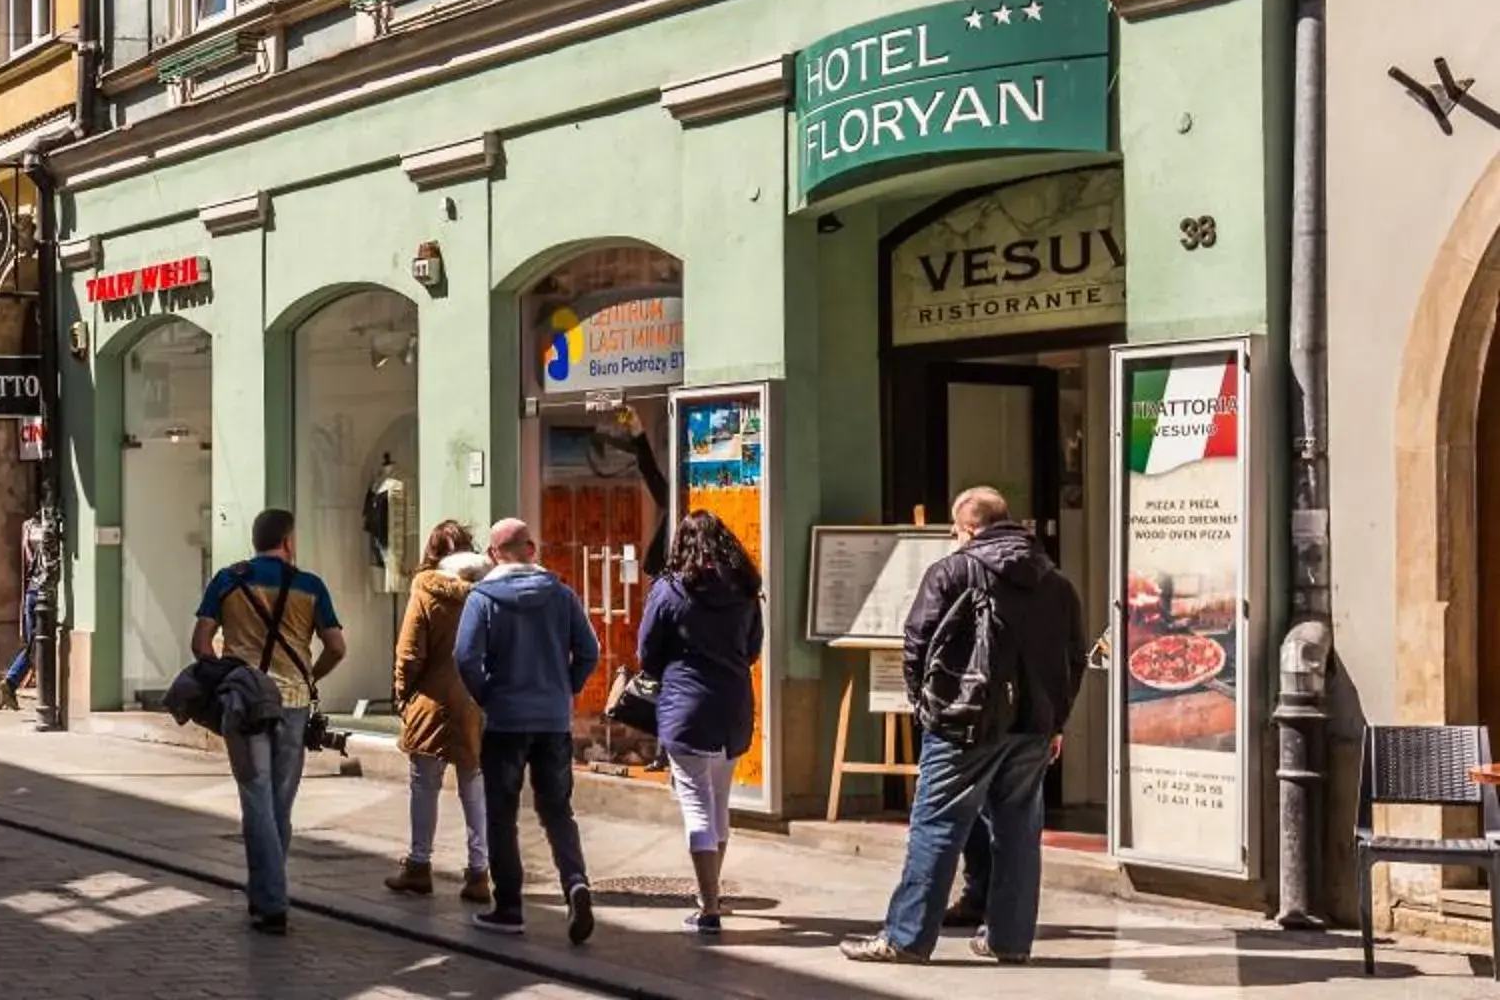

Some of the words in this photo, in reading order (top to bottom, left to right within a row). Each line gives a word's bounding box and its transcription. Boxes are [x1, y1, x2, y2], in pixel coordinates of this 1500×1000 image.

[806, 24, 949, 102] HOTEL
[805, 76, 1045, 168] FLORYAN
[1180, 215, 1217, 251] 38
[918, 228, 1126, 292] VESUV
[86, 271, 136, 302] TALLY
[919, 287, 1102, 324] RISTORANTE
[589, 328, 628, 353] LAST
[589, 359, 619, 377] Biuro
[1133, 396, 1238, 419] TRATTORIA
[1154, 423, 1218, 438] VESUVIO
[1145, 499, 1175, 510] PIZZA
[1135, 530, 1168, 541] WOOD
[1170, 529, 1197, 540] OVEN
[1200, 529, 1231, 540] PIZZA
